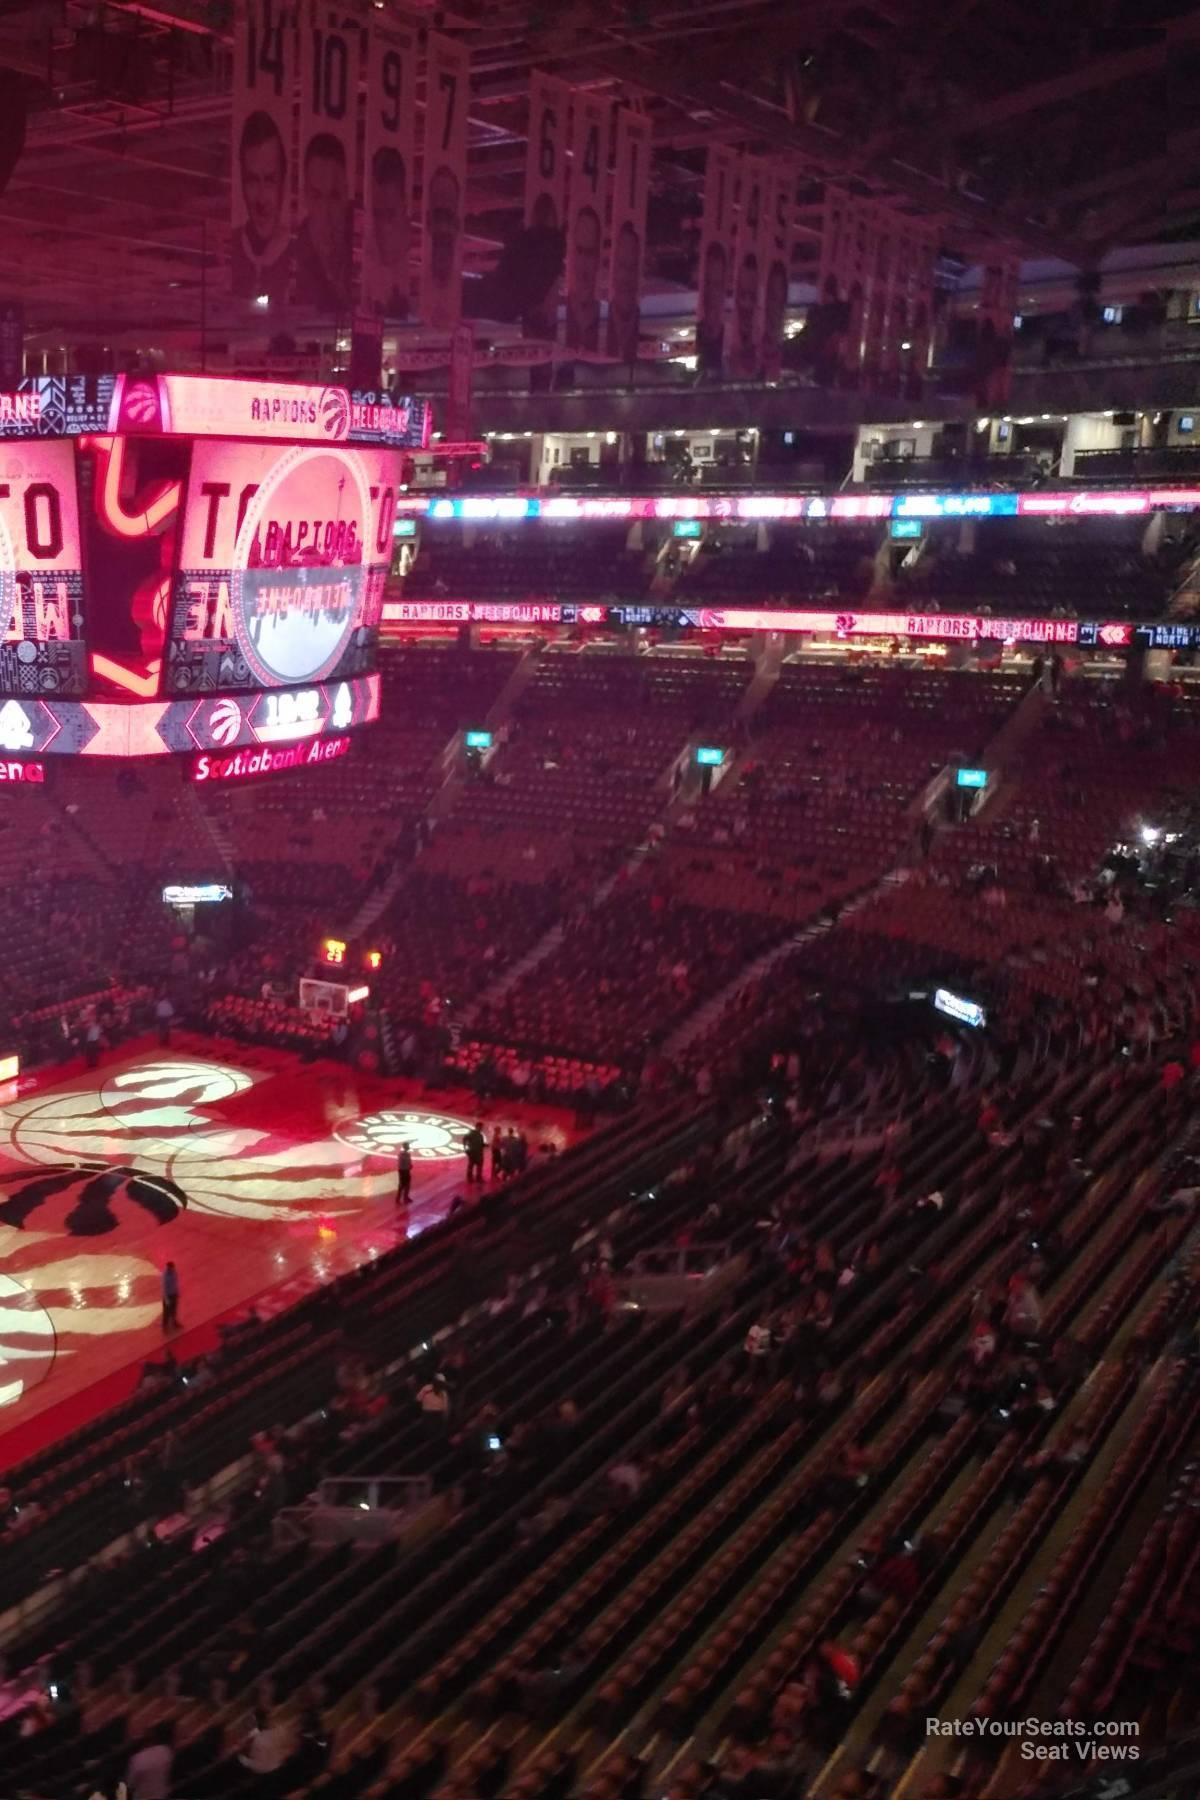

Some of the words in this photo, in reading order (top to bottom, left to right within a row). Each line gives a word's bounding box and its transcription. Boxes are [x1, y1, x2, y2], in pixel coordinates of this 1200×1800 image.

[247, 6, 283, 96] 14
[312, 28, 347, 120] 10
[382, 50, 401, 132] 9
[439, 72, 456, 149] 7
[540, 108, 557, 179] 6
[583, 124, 598, 193] 4
[252, 398, 316, 424] RAPTORS
[264, 520, 357, 555] RAPTORS
[402, 605, 463, 619] RAPTORS
[907, 618, 970, 636] RAPTORS
[1156, 634, 1189, 646] NORTH
[195, 747, 303, 780] Scotiabank
[307, 737, 351, 762] Arena
[355, 1114, 471, 1136] TORONTO
